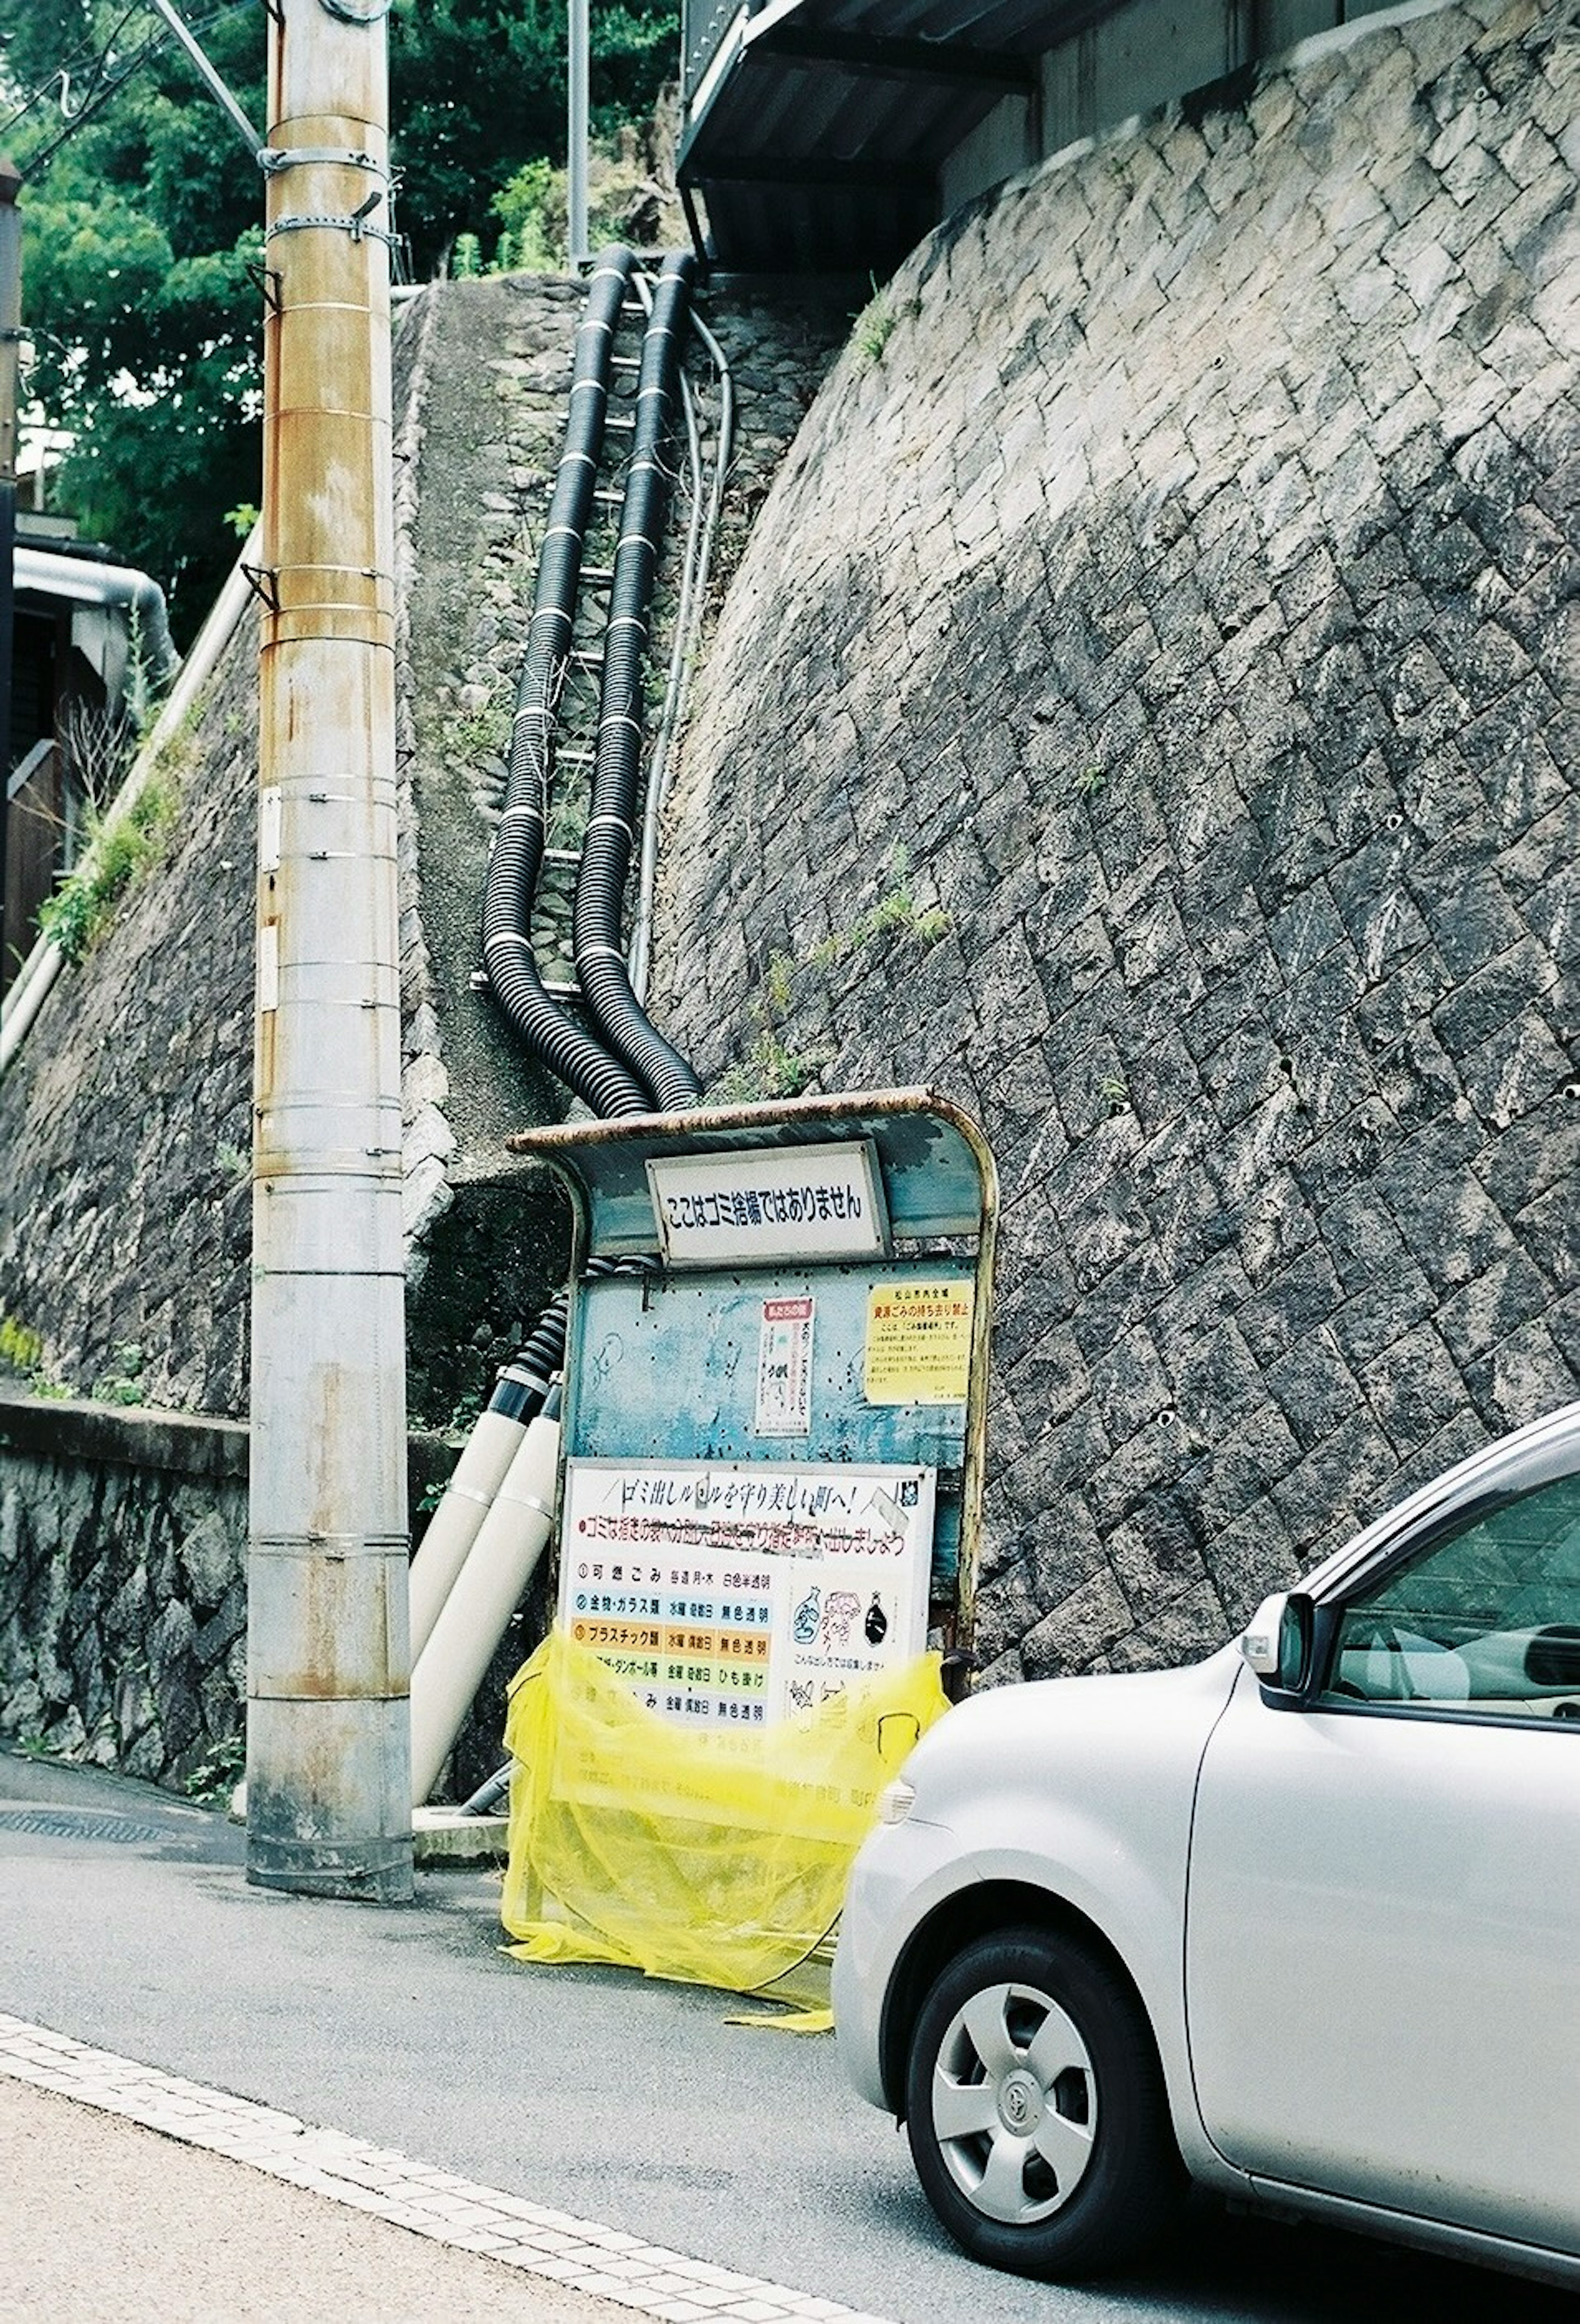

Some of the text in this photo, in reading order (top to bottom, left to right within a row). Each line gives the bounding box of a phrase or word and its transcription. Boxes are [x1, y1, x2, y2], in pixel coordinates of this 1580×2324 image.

[667, 1184, 861, 1228] ここはゴミ捨場ではありません
[624, 1479, 857, 1514] ゴミ出しルルを守り美しい町へ!
